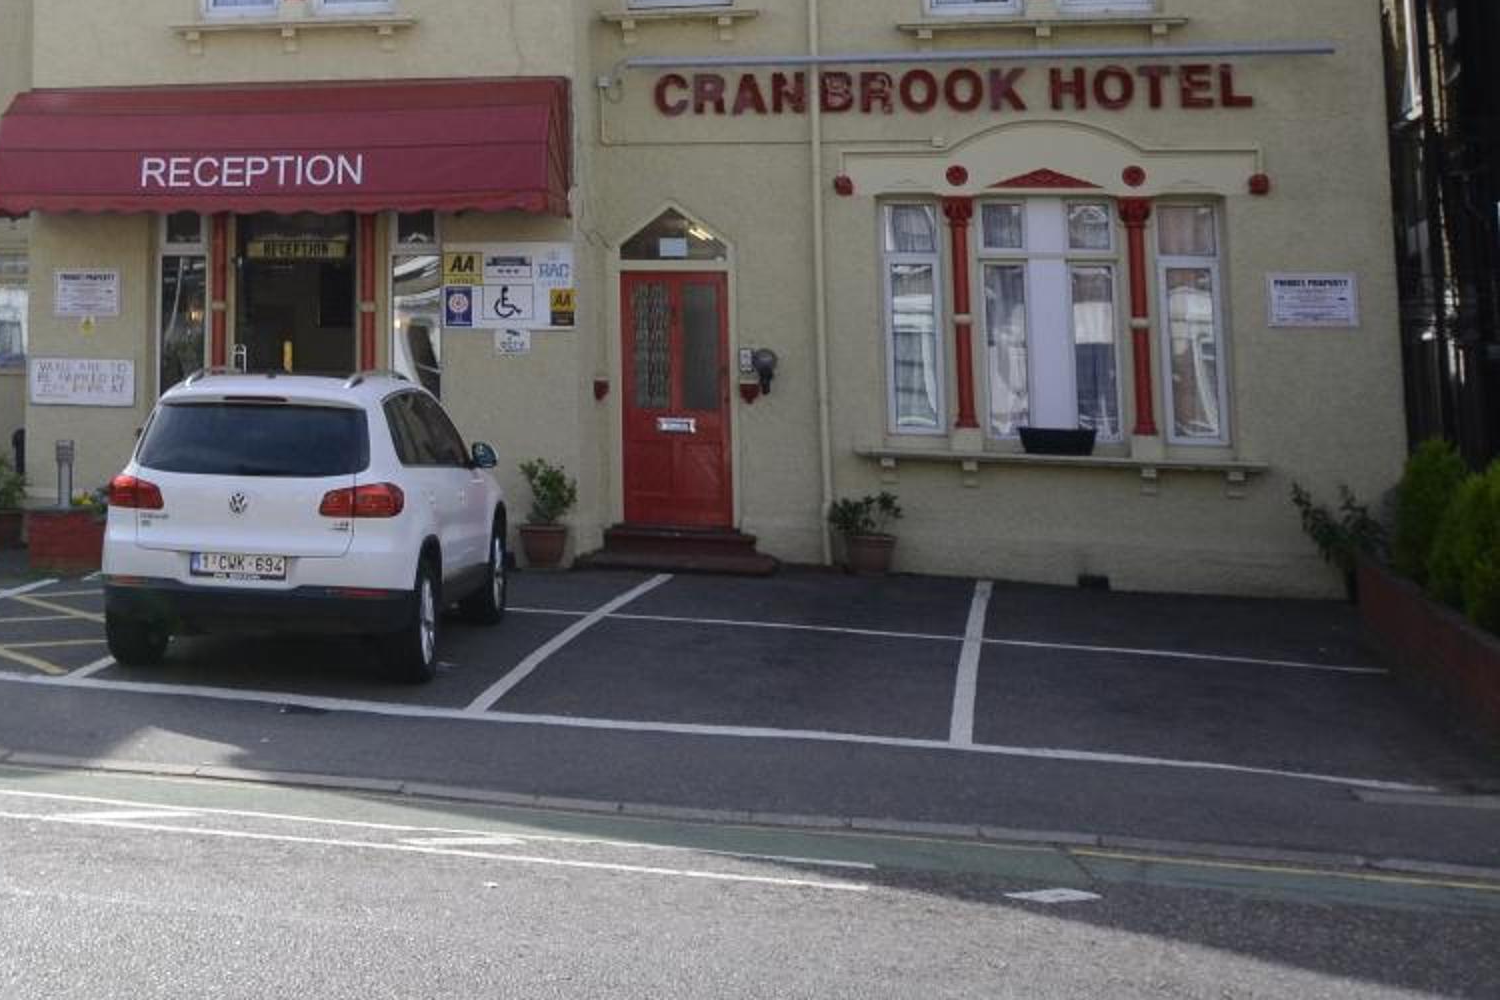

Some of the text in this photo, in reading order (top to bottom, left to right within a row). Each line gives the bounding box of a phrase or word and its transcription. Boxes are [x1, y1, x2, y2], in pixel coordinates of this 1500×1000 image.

[653, 63, 1254, 116] CRANBROOK HOTEL
[140, 154, 364, 188] RECEPTION
[263, 240, 329, 256] RECEPTION
[450, 255, 475, 273] AA
